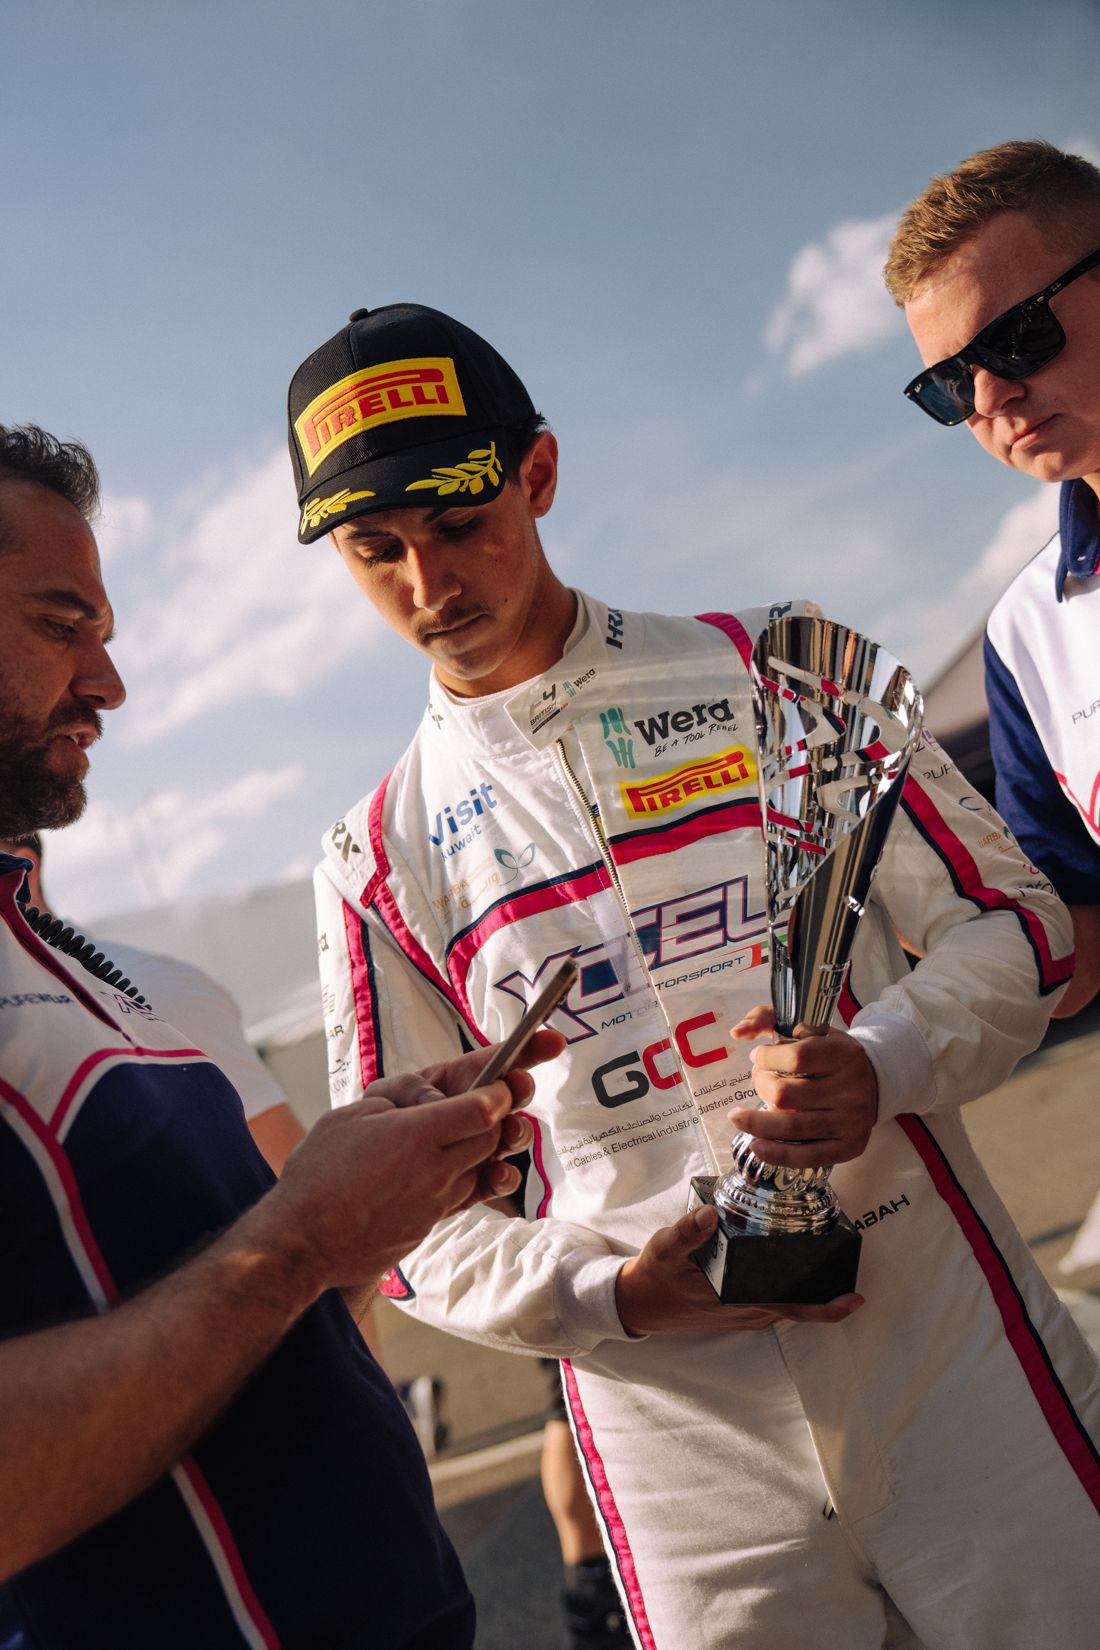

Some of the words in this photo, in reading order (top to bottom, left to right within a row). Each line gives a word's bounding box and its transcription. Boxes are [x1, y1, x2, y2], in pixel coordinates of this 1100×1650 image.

[303, 368, 450, 459] PIRELLI
[573, 668, 597, 688] Wera
[634, 698, 735, 746] Wera
[654, 742, 668, 758] BE
[671, 738, 679, 747] A
[683, 730, 706, 744] TOOL
[626, 750, 749, 813] PIRELLI
[429, 782, 497, 847] Visit
[591, 1011, 729, 1108] GCC
[572, 1150, 604, 1170] Cables
[603, 1146, 611, 1158] &
[611, 1129, 657, 1154] Electrical
[854, 1194, 911, 1231] ABAH
